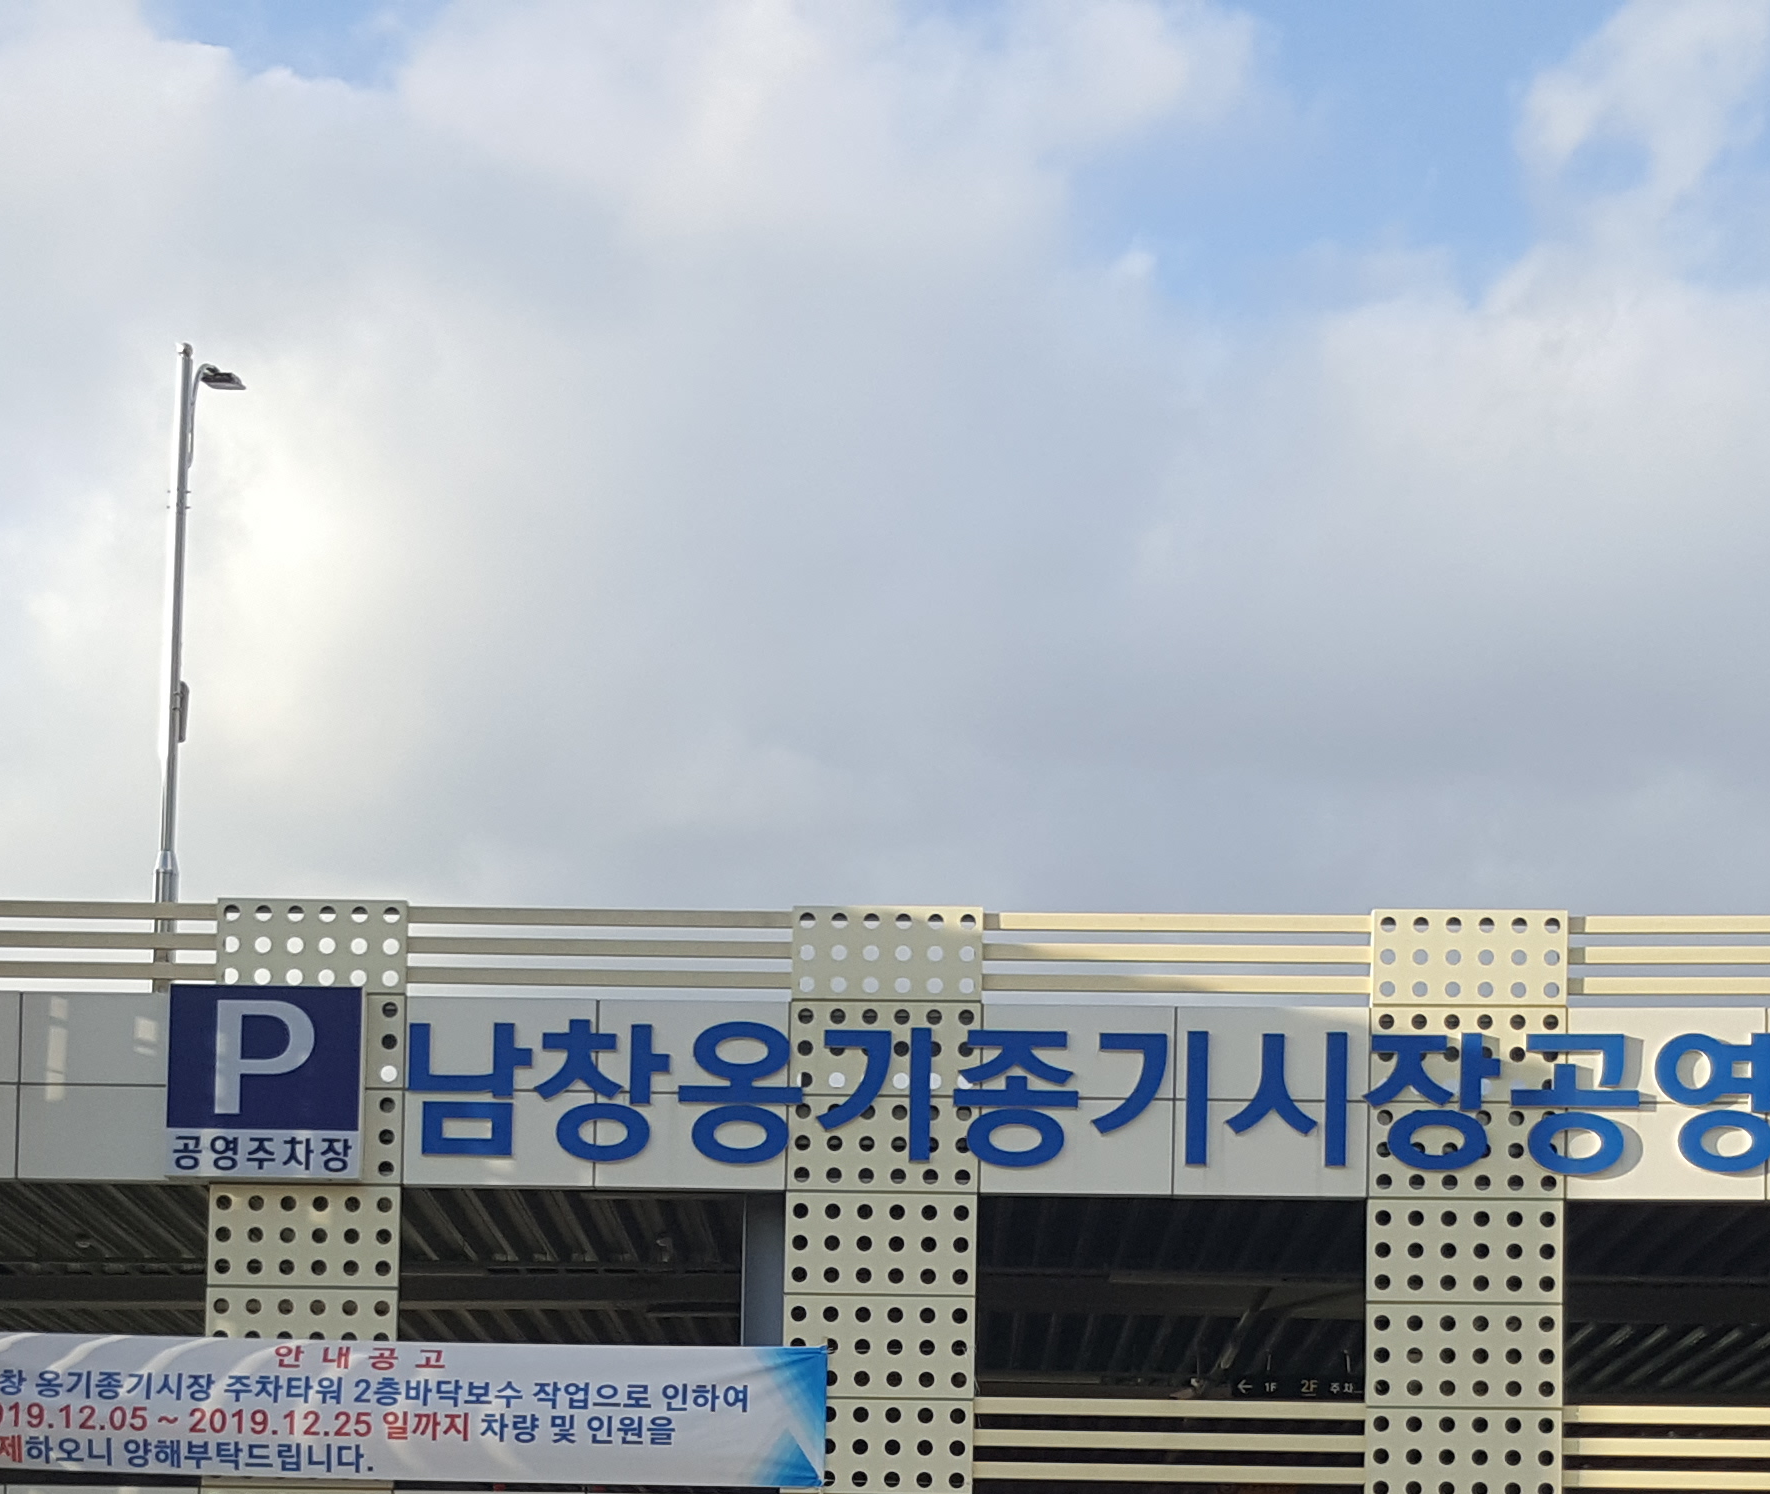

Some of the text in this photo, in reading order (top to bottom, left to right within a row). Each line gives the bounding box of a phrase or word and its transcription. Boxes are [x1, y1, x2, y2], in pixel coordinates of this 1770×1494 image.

[213, 998, 316, 1115] P
[172, 1134, 353, 1174] 공영주차장
[35, 1369, 215, 1401] 옹기종기시장
[223, 1374, 344, 1404] 주차타워
[353, 1377, 523, 1409] 2층바닥보수
[532, 1381, 652, 1410] 작업으로
[661, 1383, 749, 1413] 인하여
[188, 1407, 372, 1437] 2019.12.25
[382, 1410, 470, 1442] 일까지
[480, 1412, 540, 1444] 차량
[550, 1414, 577, 1444] 및
[586, 1415, 676, 1446] 인원을
[123, 1438, 374, 1473] 양해부탁드립니다.
